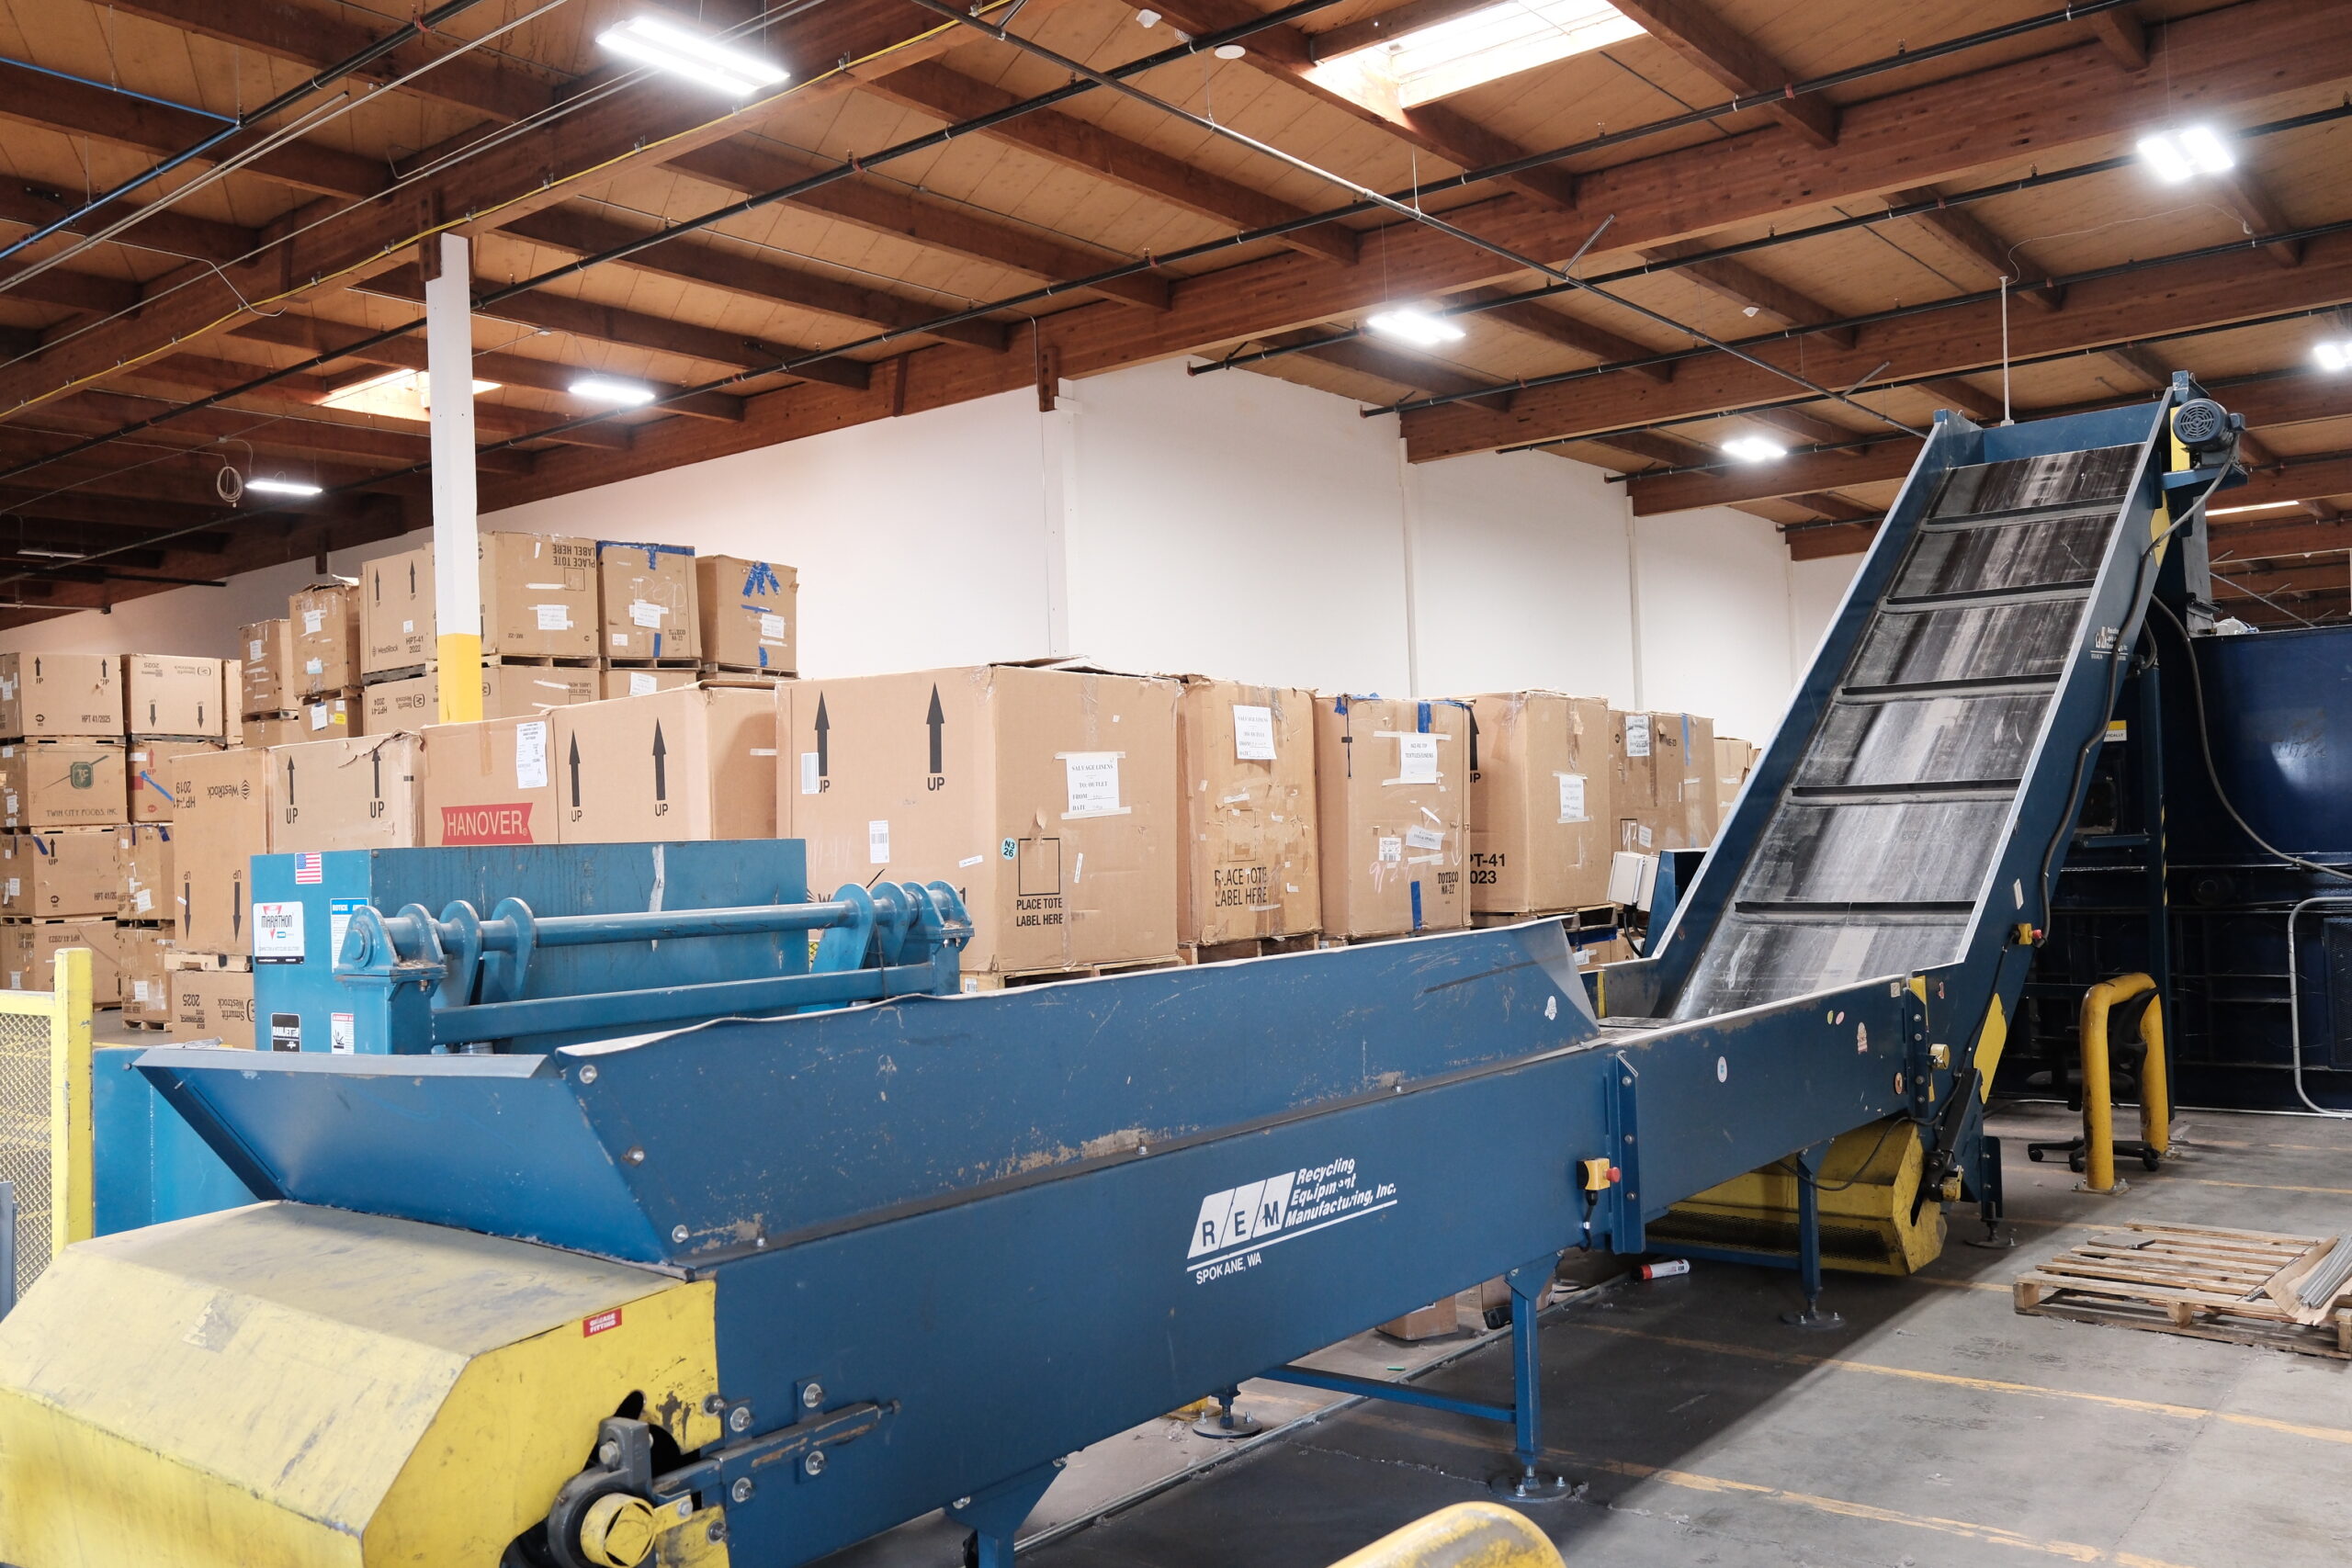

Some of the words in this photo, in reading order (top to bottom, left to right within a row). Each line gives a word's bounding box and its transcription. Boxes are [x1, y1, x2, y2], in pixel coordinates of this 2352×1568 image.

[552, 544, 571, 555] HERE
[574, 546, 595, 557] LABEL
[553, 556, 571, 567] TOTE
[573, 558, 595, 568] PLACE
[405, 636, 424, 644] HPT-41
[378, 644, 399, 654] WestRock
[409, 645, 422, 654] 2022
[82, 715, 91, 723] HPT
[927, 776, 945, 791] UP
[1470, 773, 1481, 783] P
[175, 781, 191, 794] 2019
[207, 784, 239, 798] WestRock
[173, 796, 196, 809] HP-41
[370, 800, 384, 818] UP
[286, 807, 299, 824] UP
[571, 809, 582, 822] UP
[655, 804, 669, 817] UP
[1004, 840, 1015, 850] N3
[1003, 848, 1014, 858] 26
[184, 870, 191, 881] UP
[233, 869, 242, 880] UP
[1437, 871, 1459, 884] TOTECO
[1470, 870, 1498, 885] 023
[1442, 884, 1455, 895] NA-22
[94, 892, 104, 901] HPT
[1215, 888, 1243, 908] LABEL
[1245, 886, 1267, 905] HERE
[1016, 898, 1042, 910] PLACE
[1043, 897, 1063, 908] TOTE
[261, 915, 293, 929] MARATHON
[1016, 915, 1041, 927] LABEL
[1043, 913, 1063, 925] HERE
[183, 994, 200, 1007] 2025
[217, 998, 244, 1009] Westrock
[220, 1010, 245, 1021] Smurfit
[1295, 1156, 1356, 1186] Recycling
[1284, 1189, 1374, 1228] Manufacturing,
[1375, 1182, 1397, 1200] Inc.
[1202, 1200, 1280, 1247] REM
[1195, 1257, 1247, 1285] SPOKANE,
[1247, 1252, 1262, 1268] WA
[590, 1319, 616, 1334] FITTING
